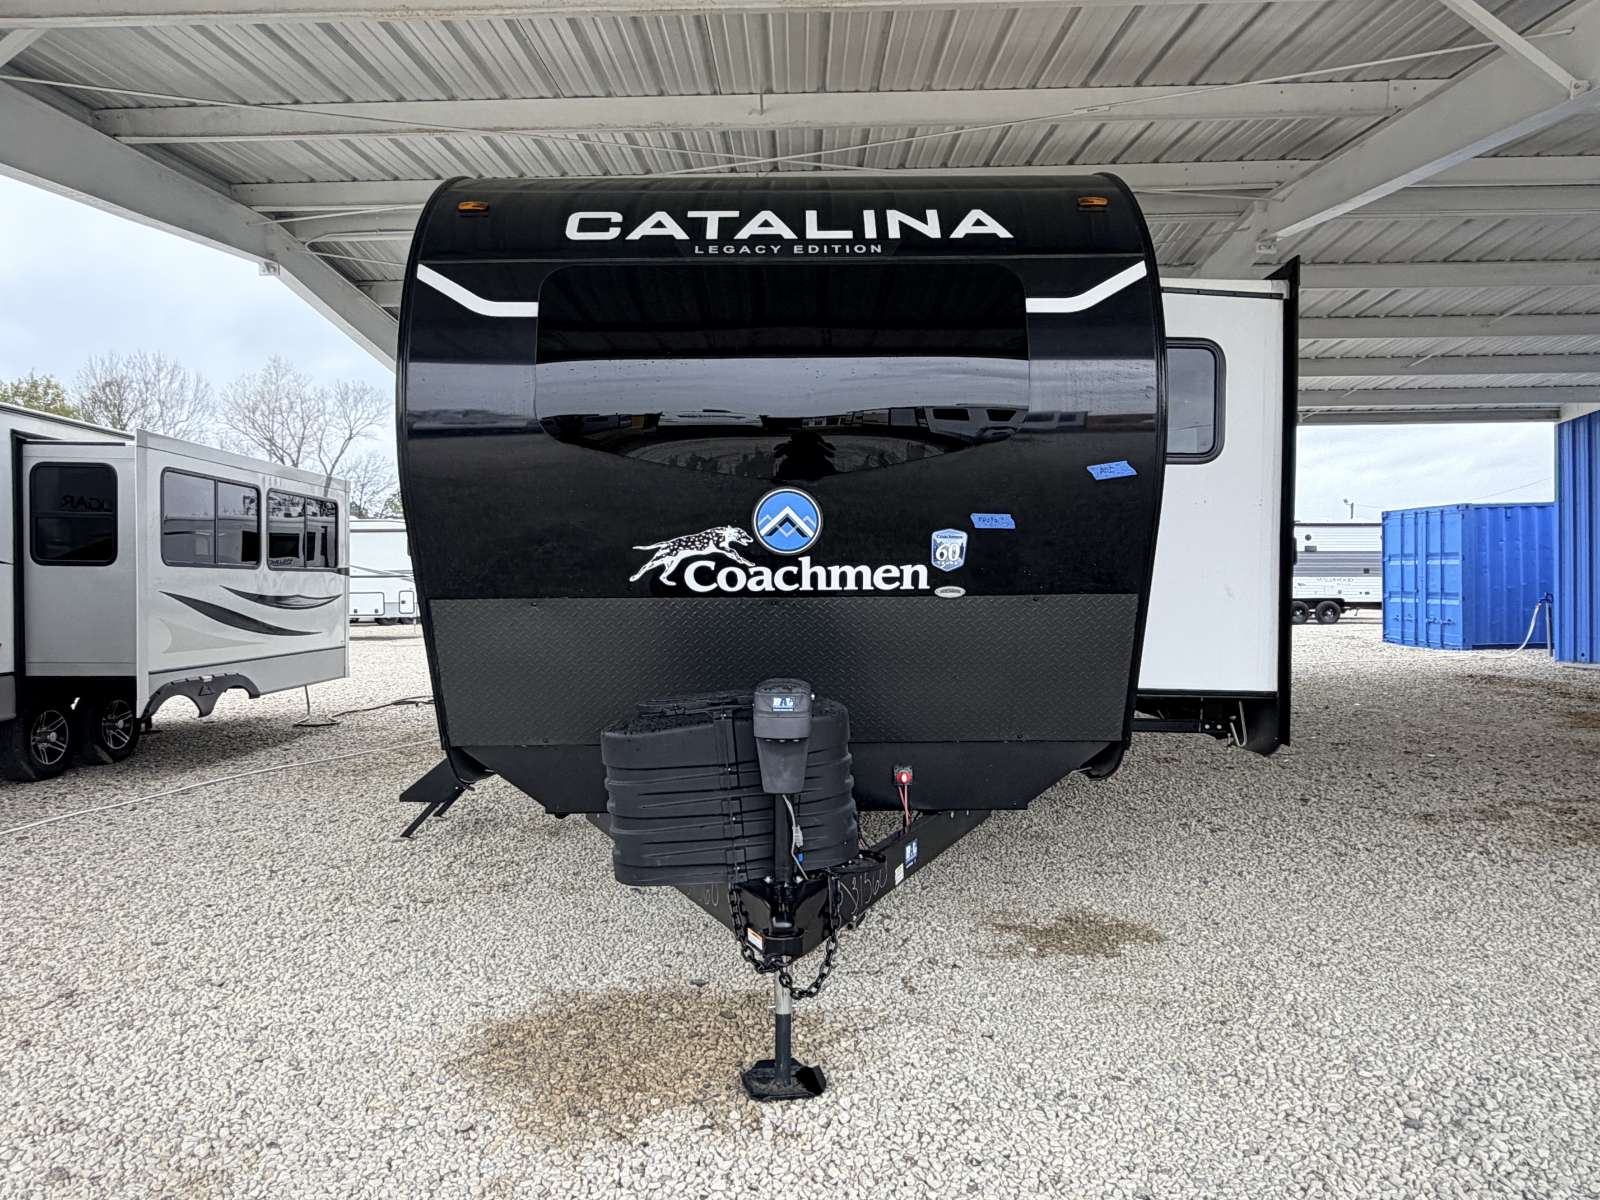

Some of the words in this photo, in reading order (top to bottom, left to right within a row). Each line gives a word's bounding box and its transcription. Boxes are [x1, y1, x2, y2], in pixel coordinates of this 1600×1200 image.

[565, 208, 1014, 241] CATALINA
[694, 244, 781, 255] LEGACY
[793, 244, 883, 254] EDITION
[935, 543, 961, 561] 60
[684, 556, 930, 593] Coachmen
